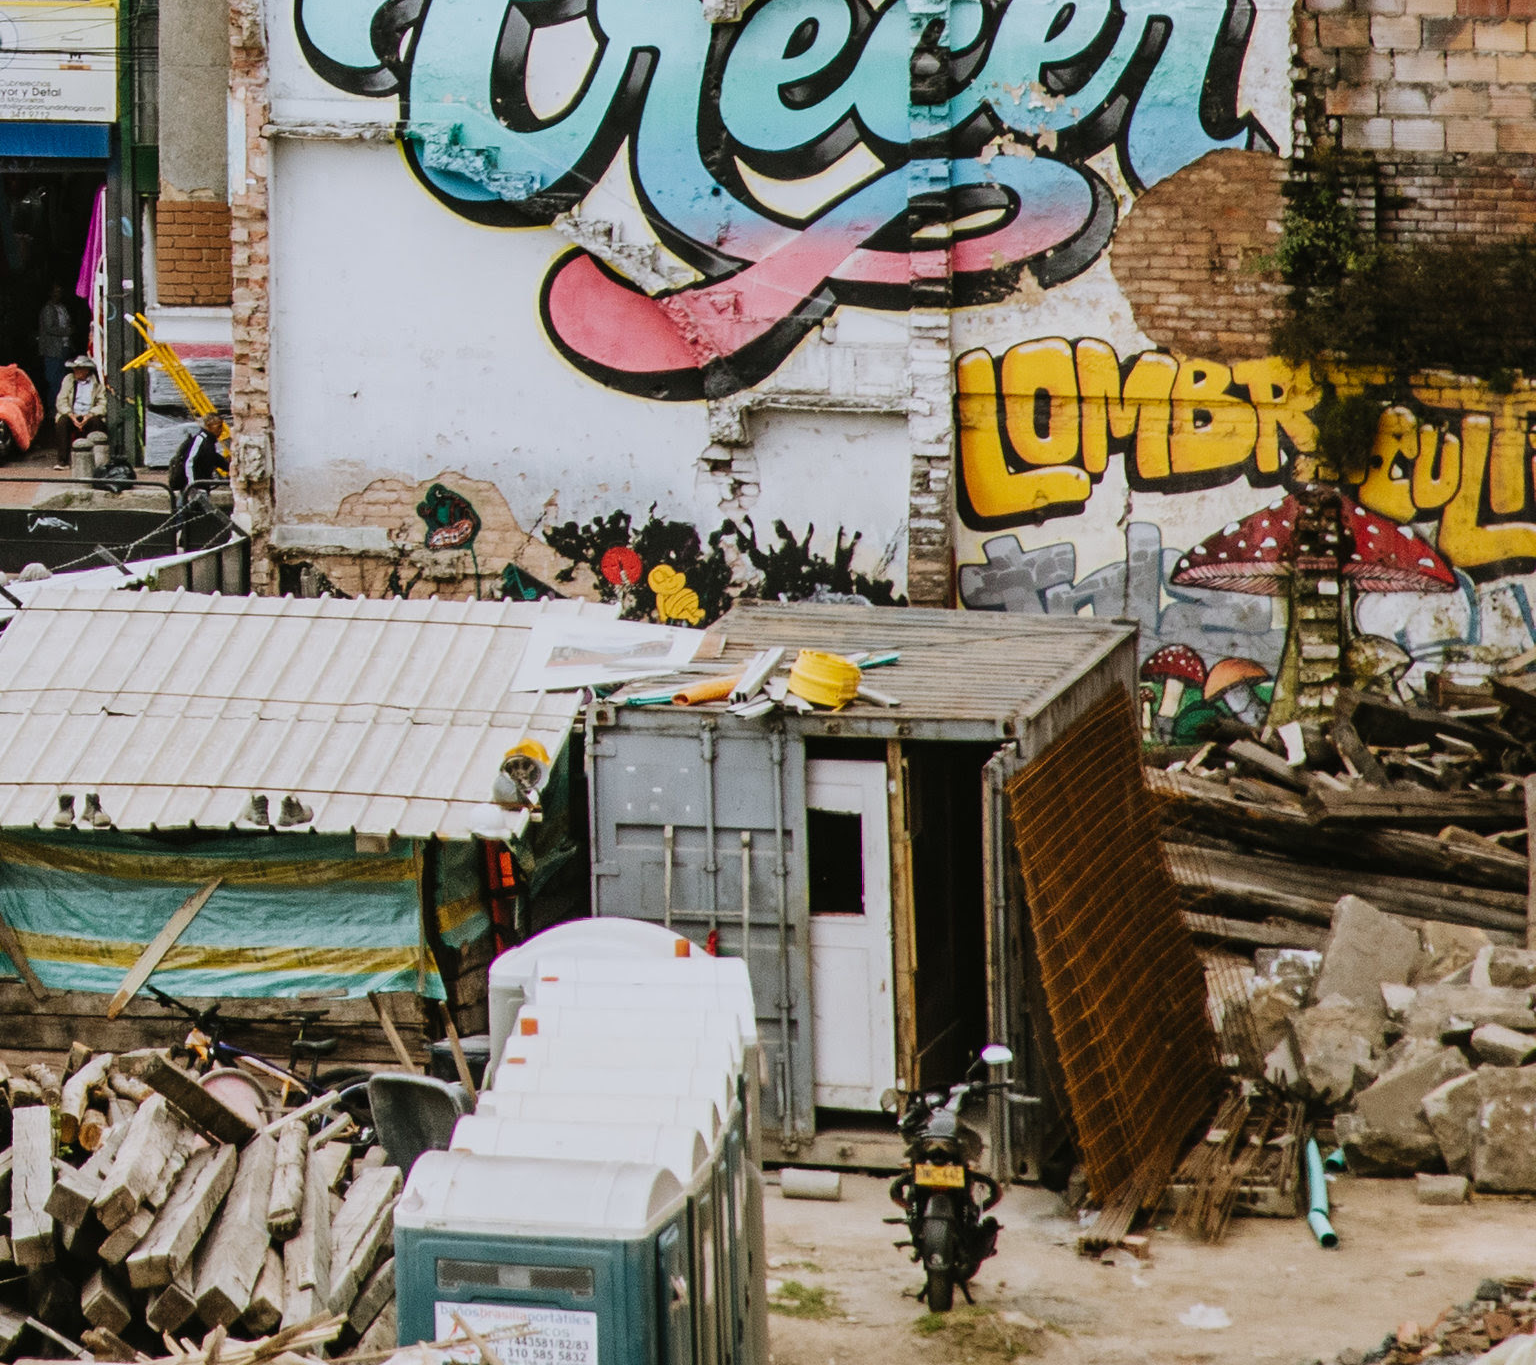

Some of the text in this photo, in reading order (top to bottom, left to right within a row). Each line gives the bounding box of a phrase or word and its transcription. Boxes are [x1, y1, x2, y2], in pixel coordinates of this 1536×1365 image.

[31, 87, 62, 97] Detal
[507, 1348, 587, 1363] 310 585 5832
